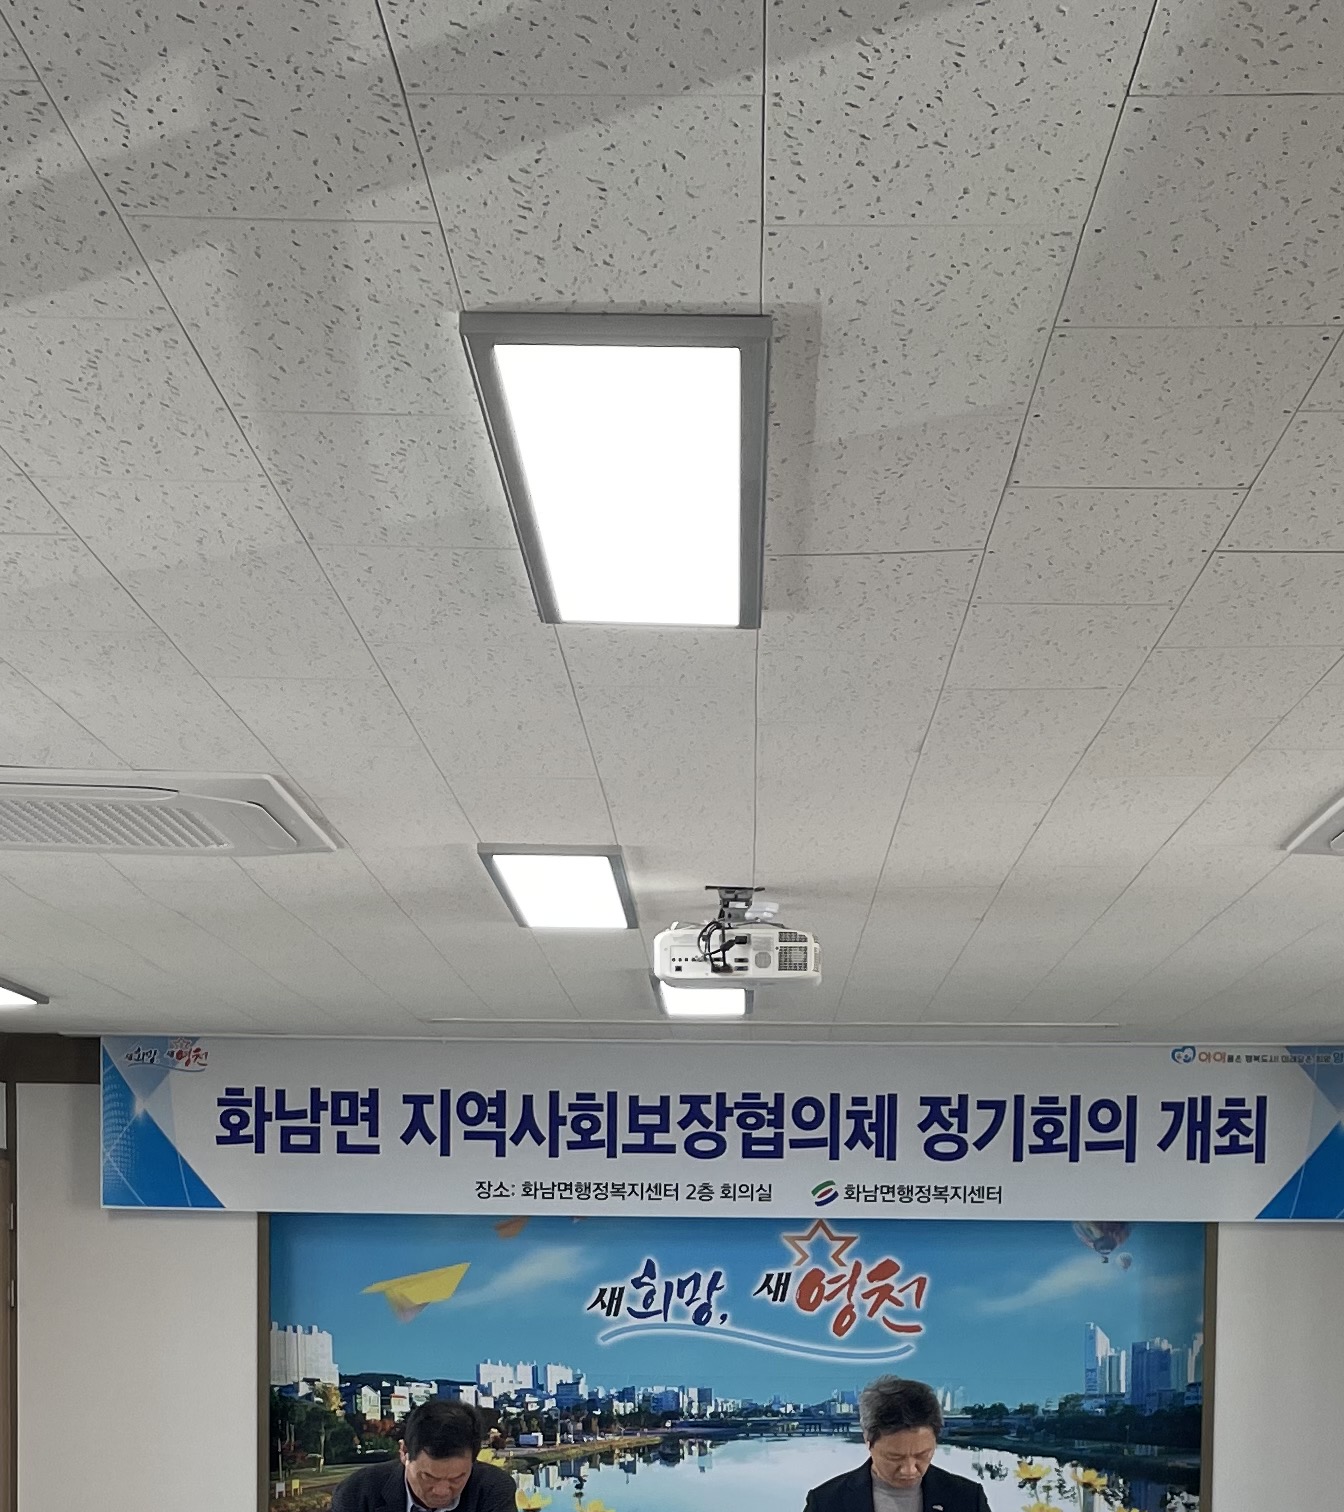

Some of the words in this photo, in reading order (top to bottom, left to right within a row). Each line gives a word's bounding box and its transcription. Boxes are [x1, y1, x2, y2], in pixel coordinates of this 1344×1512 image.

[215, 1086, 382, 1155] 화남면
[399, 1087, 899, 1162] 지역사회보장협의체
[916, 1092, 1139, 1164] 정기회의
[1156, 1095, 1269, 1165] 개최
[474, 1180, 516, 1200] 장소:
[520, 1180, 680, 1202] 화남면행정복지센터
[685, 1182, 715, 1202] 2층
[719, 1182, 773, 1202] 회의실
[843, 1183, 1003, 1205] 화남면행정복지센터
